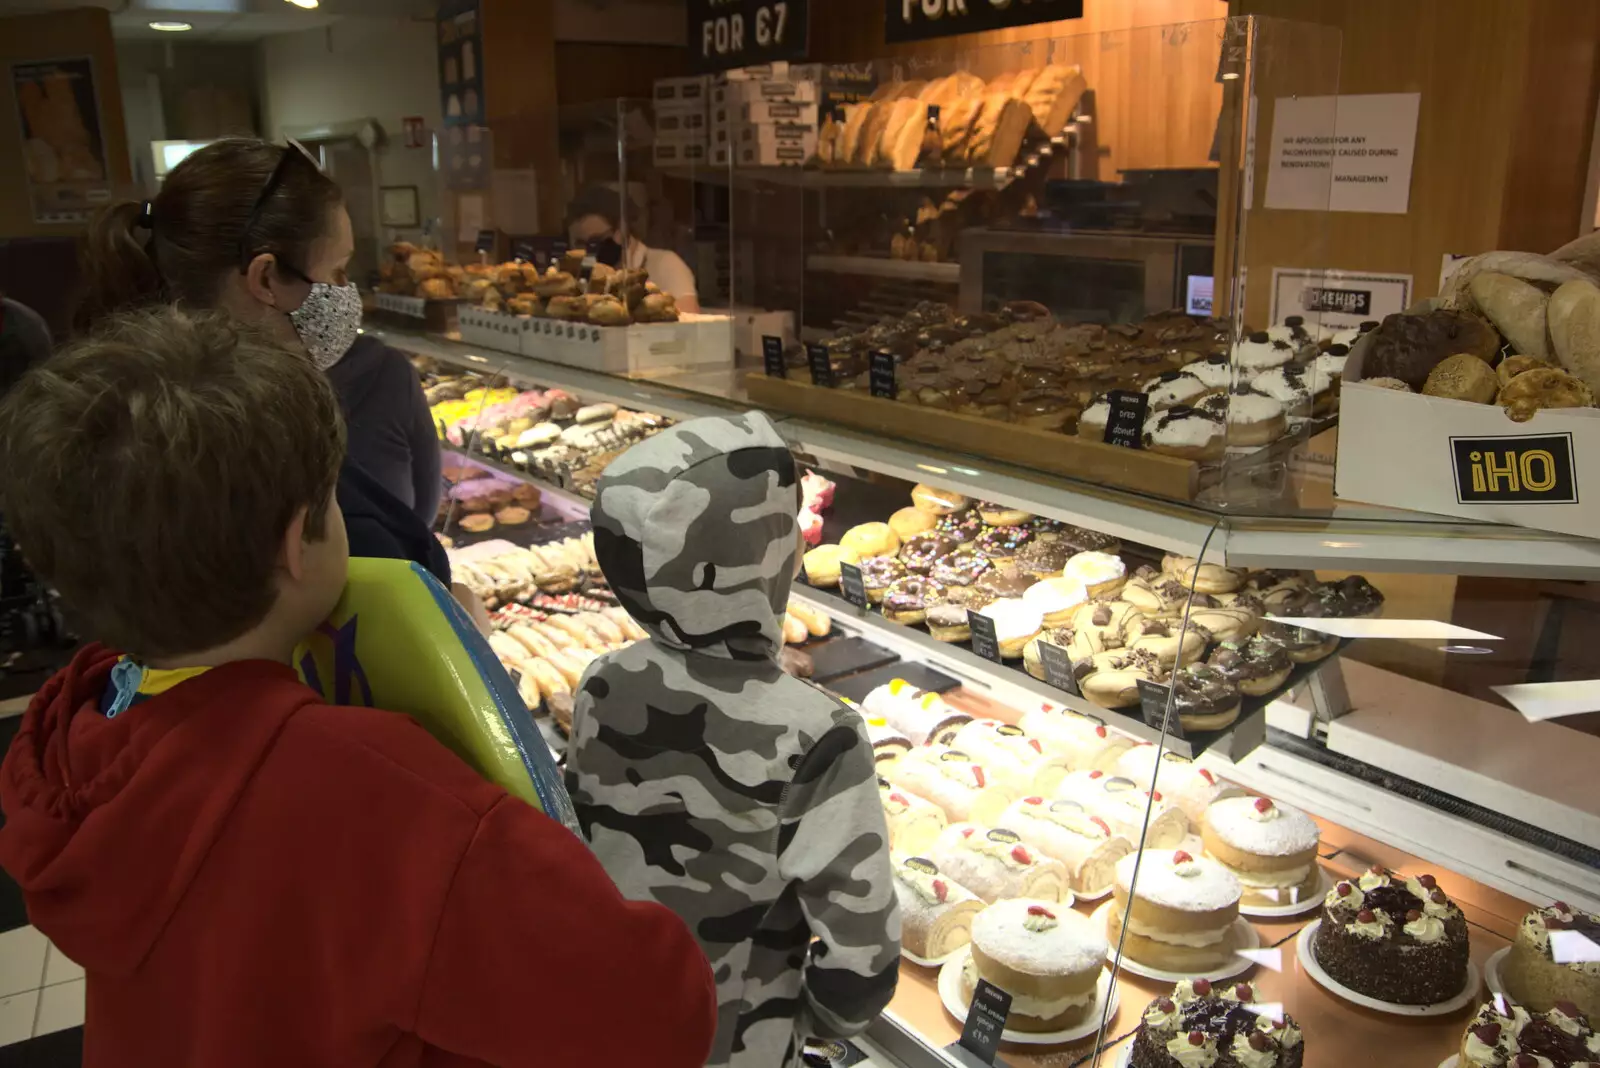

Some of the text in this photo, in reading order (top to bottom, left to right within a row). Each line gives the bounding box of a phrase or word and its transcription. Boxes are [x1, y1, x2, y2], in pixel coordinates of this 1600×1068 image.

[703, 2, 786, 56] FOR €7
[1335, 136, 1350, 144] FOR
[1351, 136, 1366, 144] ANY
[1338, 148, 1367, 157] CAUSED
[1368, 148, 1399, 157] DURING
[1334, 174, 1389, 183] MANAGEMENT
